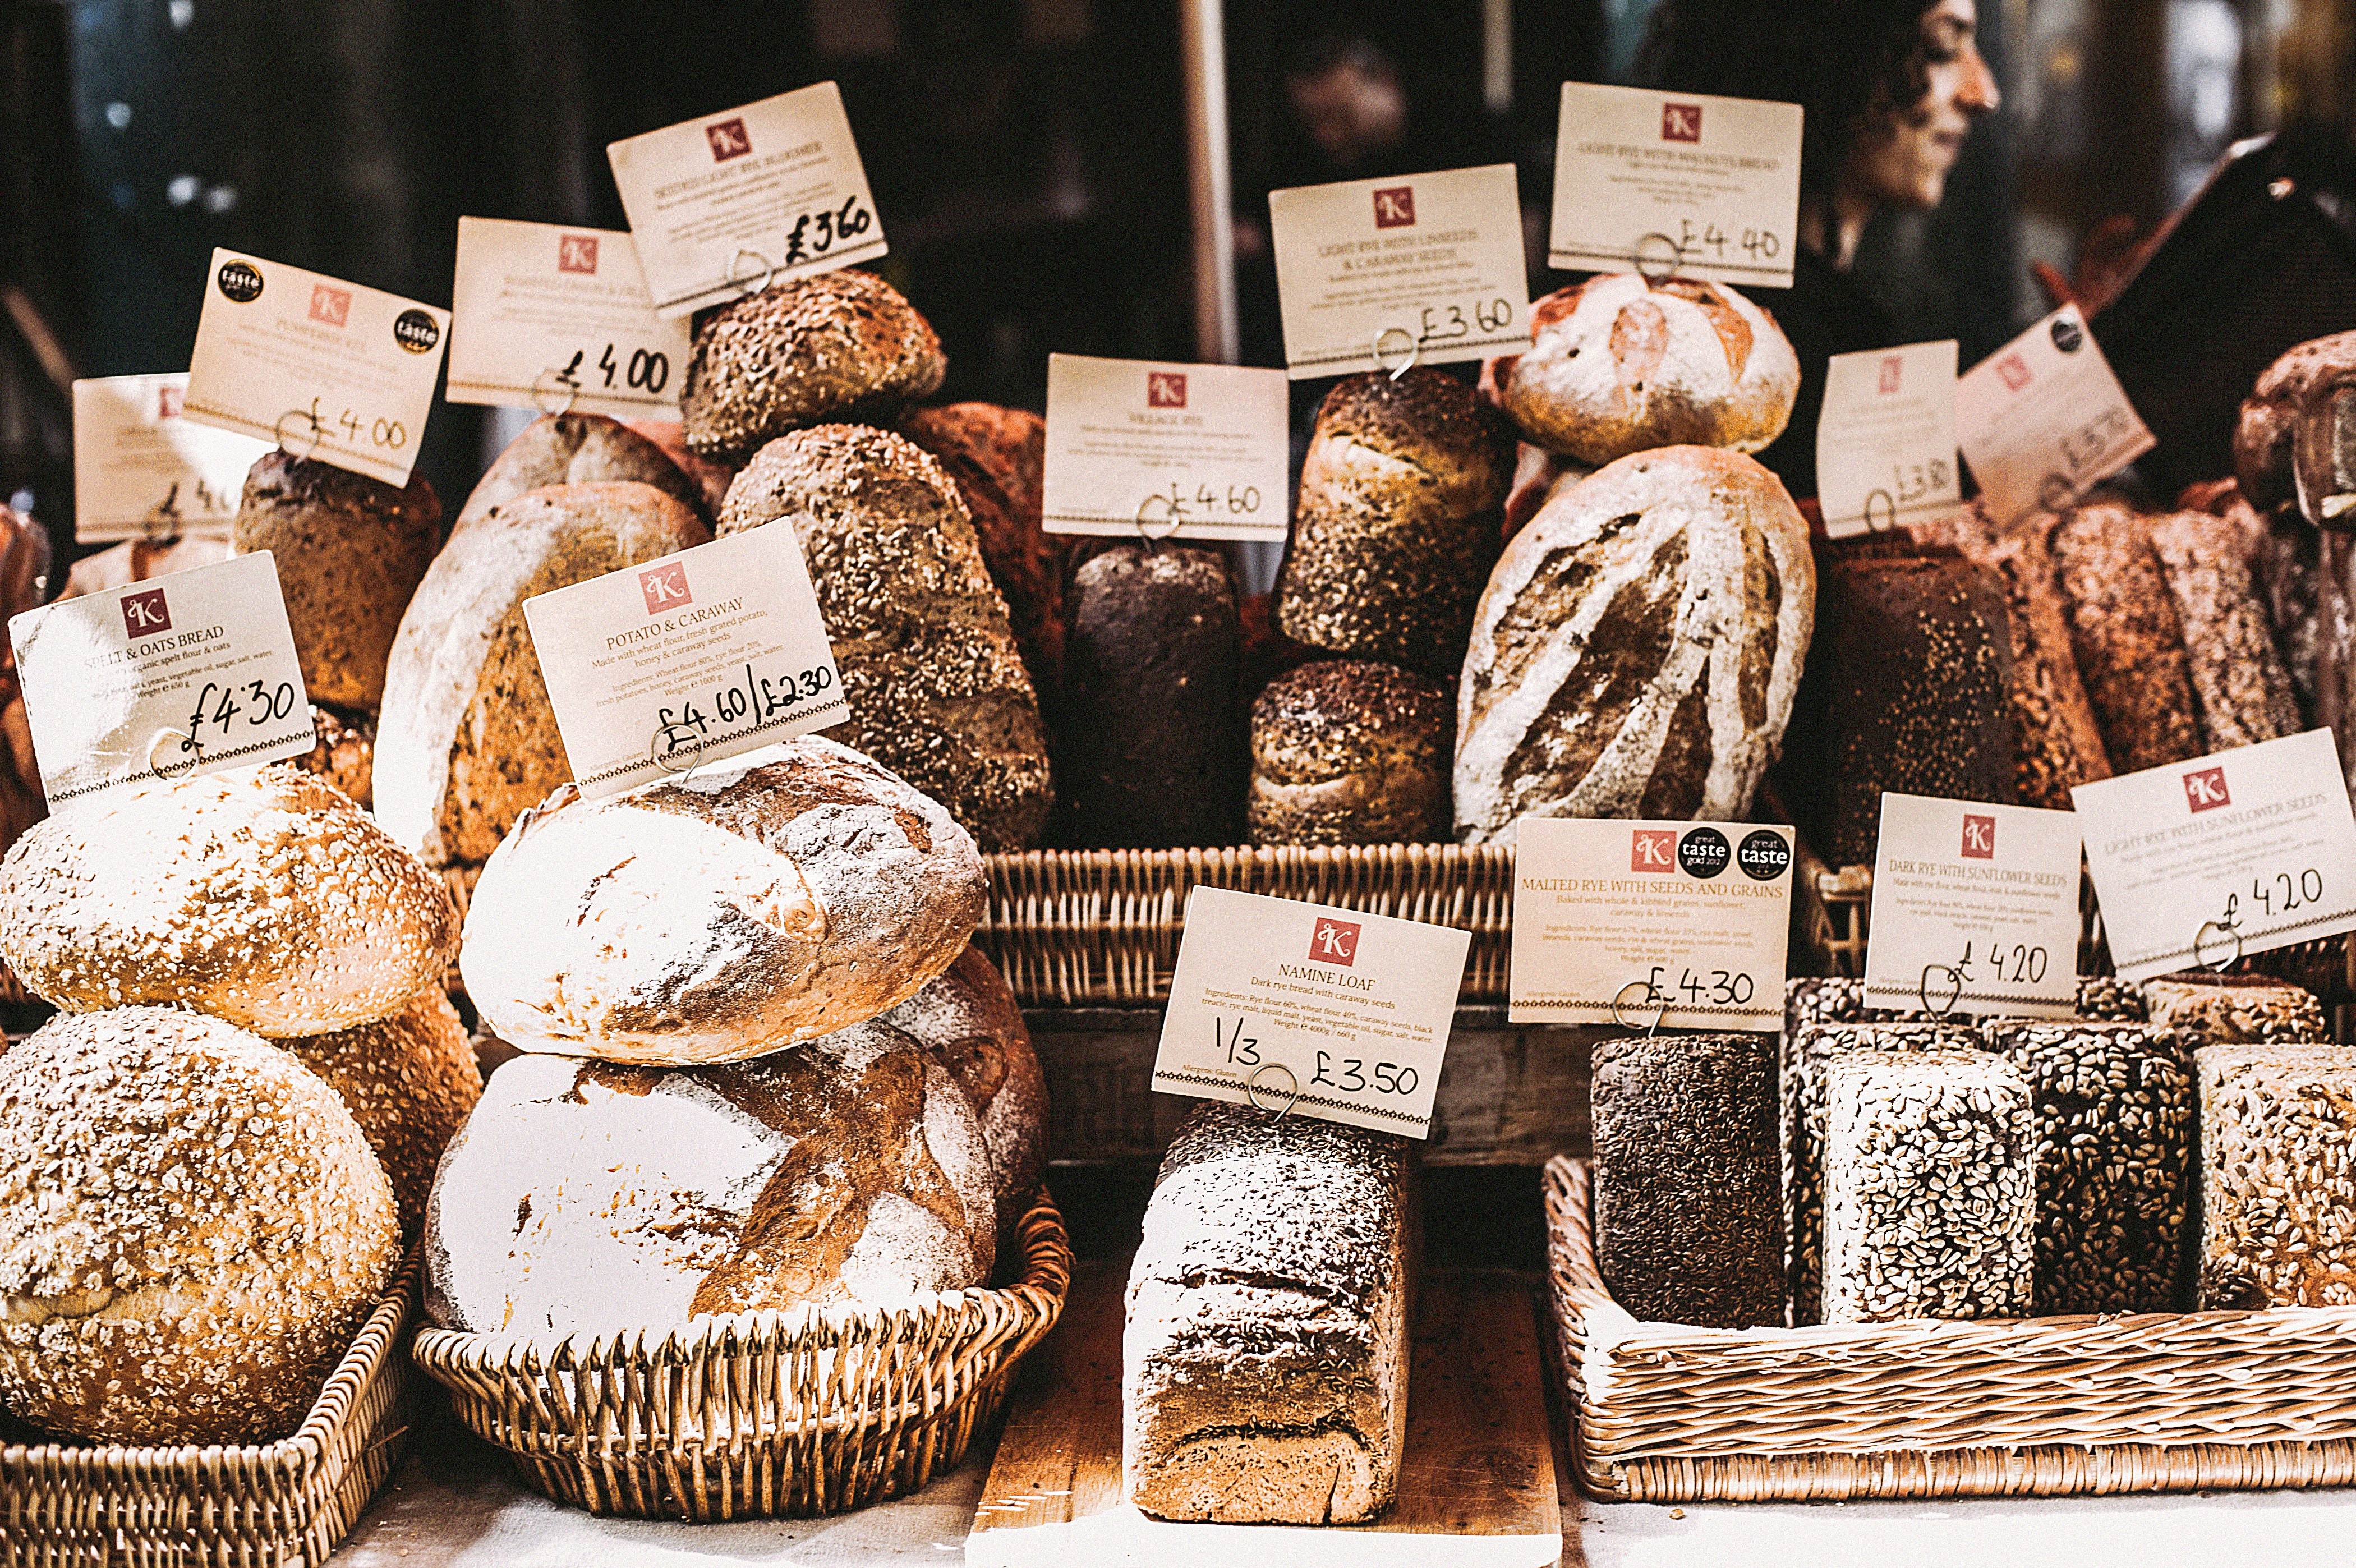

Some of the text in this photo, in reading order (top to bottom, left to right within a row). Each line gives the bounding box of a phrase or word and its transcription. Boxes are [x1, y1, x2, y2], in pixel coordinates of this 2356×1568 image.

[222, 270, 260, 288] taste
[397, 321, 436, 343] taste
[642, 565, 687, 608] K
[125, 591, 166, 631] K
[606, 596, 742, 650] POTATO & CARAWAY
[84, 626, 224, 669] SPELT & OATS BREAD
[160, 642, 231, 666] spelt flour & oats
[591, 610, 768, 669] Made with wheat flour, fresh grated potato,
[634, 632, 731, 668] honey & caraway seeds
[168, 667, 203, 680] vegetable
[611, 675, 654, 692] Ingredients:
[655, 666, 679, 678] Wheat
[679, 661, 697, 672] flour
[715, 652, 727, 661] rye
[728, 646, 746, 656] flour
[664, 674, 716, 696] Weight 1000
[595, 696, 615, 707] fresh
[615, 687, 650, 704] potatoes,
[673, 670, 703, 683] caraway
[2184, 768, 2228, 808] K
[1695, 836, 1715, 844] great
[1751, 839, 1778, 850] great
[1964, 817, 1993, 853] K
[2104, 836, 2141, 856] LIGHT
[2170, 821, 2205, 838] WITH
[2206, 802, 2284, 831] SUNFLOWER
[1635, 833, 1673, 866] K
[1683, 843, 1726, 857] taste
[1687, 856, 1705, 866] gold
[1741, 849, 1788, 865] taste
[1521, 877, 1783, 898] MALTED RYE WITH SEEDS AND GRAINS
[1889, 858, 2067, 888] DARK RYE WITH SUNFLOWER SEEDS
[1556, 894, 1583, 904] Baked
[1313, 921, 1357, 959] K
[1250, 976, 1395, 1009] Dark rye bread with caraway seeds
[1278, 963, 1375, 991] NAMINE LOAF
[1644, 966, 1754, 1005] £4.30
[1205, 987, 1248, 1001] Ingredients:
[1249, 994, 1263, 1004] Rye
[1264, 997, 1282, 1006] flour
[1300, 1004, 1323, 1013] wheat
[1323, 1007, 1341, 1017] flour
[1359, 1015, 1389, 1028] caraway
[1414, 1024, 1433, 1034] black
[1228, 1003, 1241, 1011] rye
[1261, 1006, 1283, 1017] liquid
[1324, 1019, 1360, 1030] vegetable
[1273, 1018, 1299, 1029] Weight
[1216, 1017, 1260, 1066] 1/3
[1214, 1068, 1237, 1081] Gluten
[1310, 1050, 1419, 1095] £3.50
